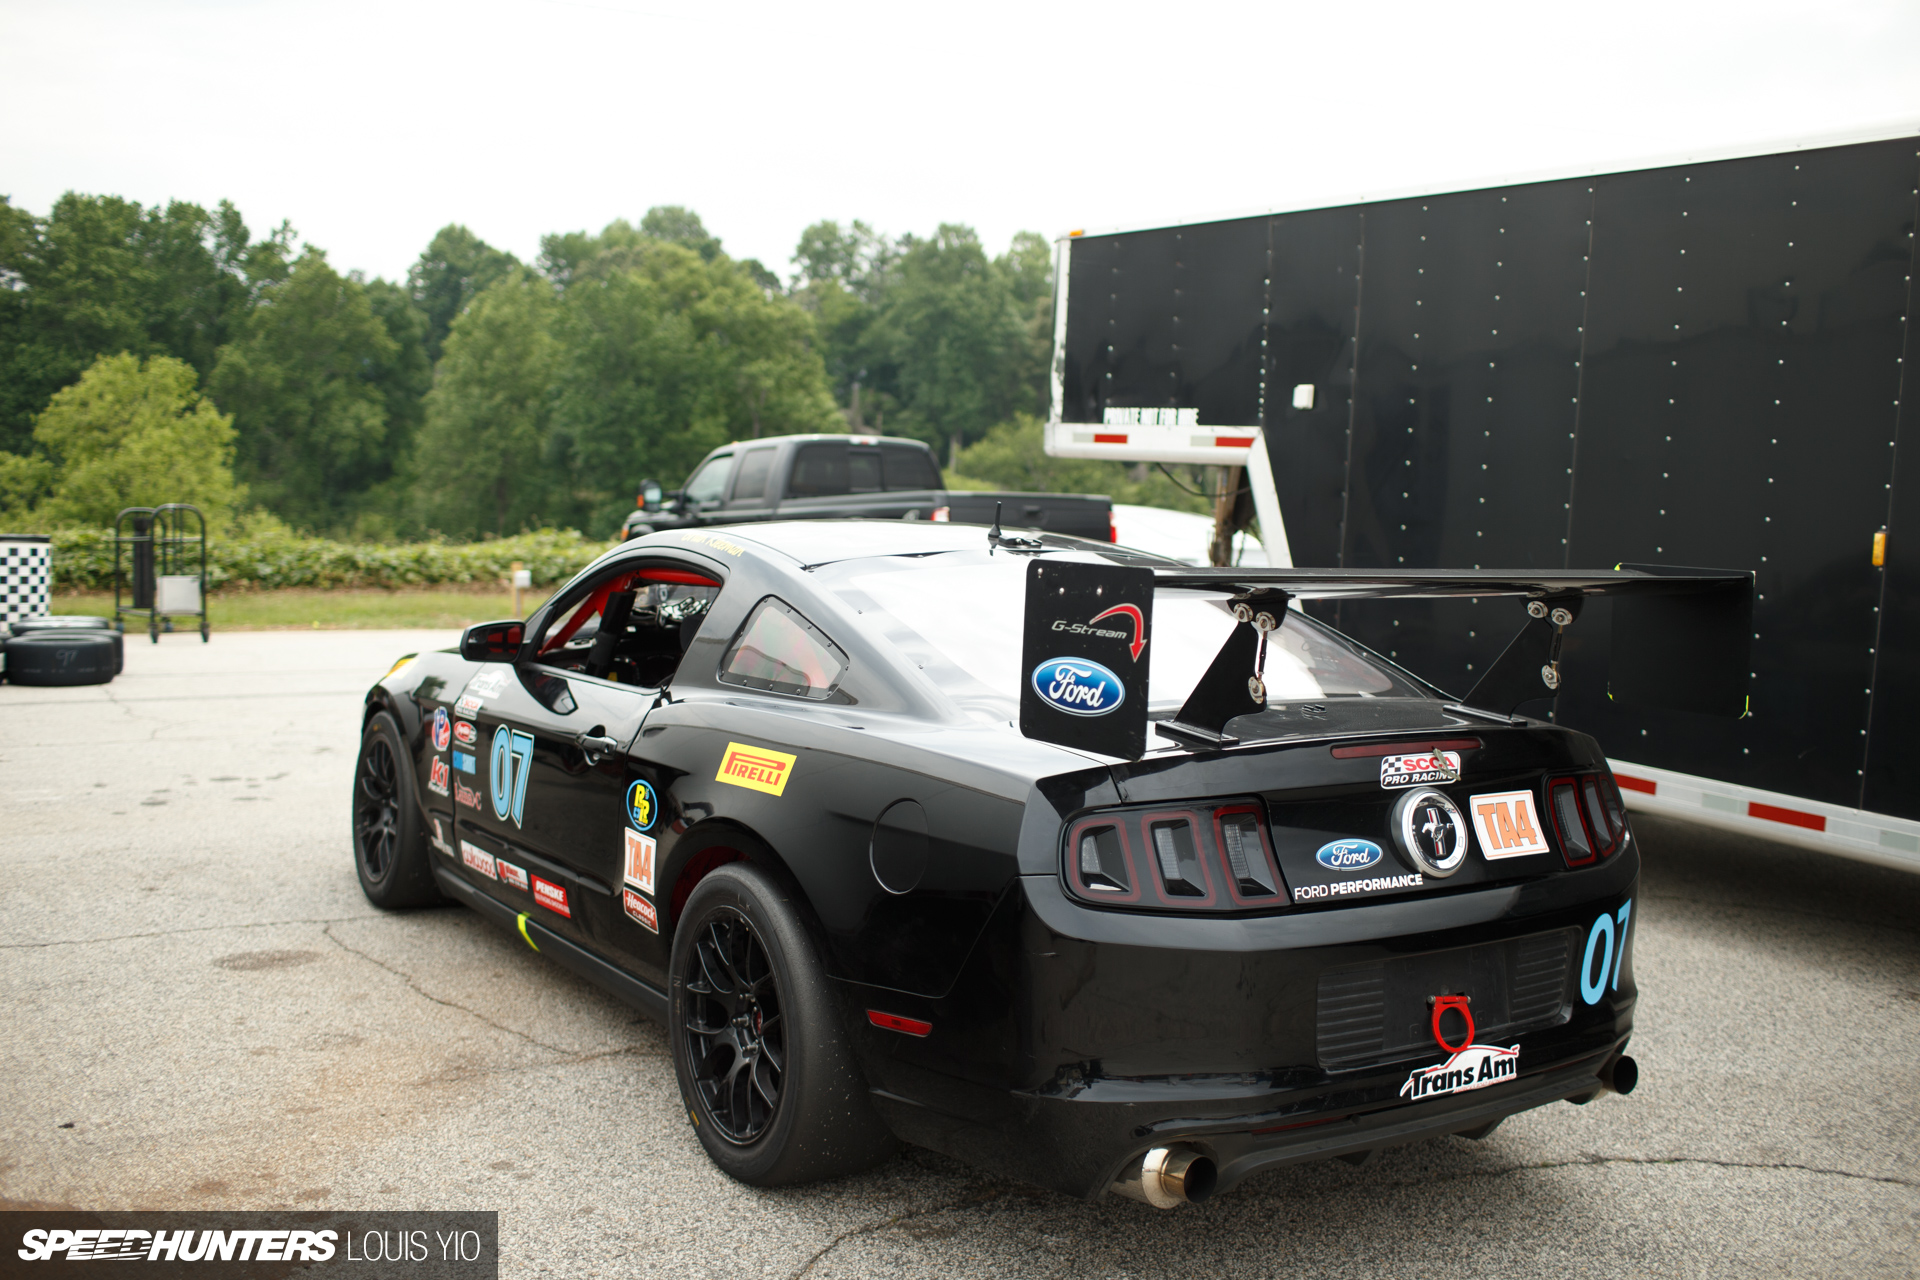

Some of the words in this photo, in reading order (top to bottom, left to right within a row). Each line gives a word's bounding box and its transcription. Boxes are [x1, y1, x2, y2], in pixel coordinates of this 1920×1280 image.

[1051, 620, 1128, 640] G-Stream
[1048, 664, 1106, 708] Ford
[490, 723, 535, 830] 07
[724, 751, 786, 786] PIRELLI
[1403, 756, 1456, 772] SCCA
[1383, 774, 1410, 786] PRO
[1477, 800, 1538, 850] TA4
[627, 836, 652, 886] TA4
[1331, 844, 1371, 866] Ford
[535, 880, 565, 902] PENSKE
[1294, 884, 1329, 900] FORD
[1330, 873, 1424, 896] PERFORMANCE
[626, 892, 655, 921] Heacock
[632, 910, 652, 927] CLASSIC
[1580, 898, 1632, 1005] 07
[1411, 1067, 1474, 1097] Trans
[1477, 1055, 1515, 1082] Am
